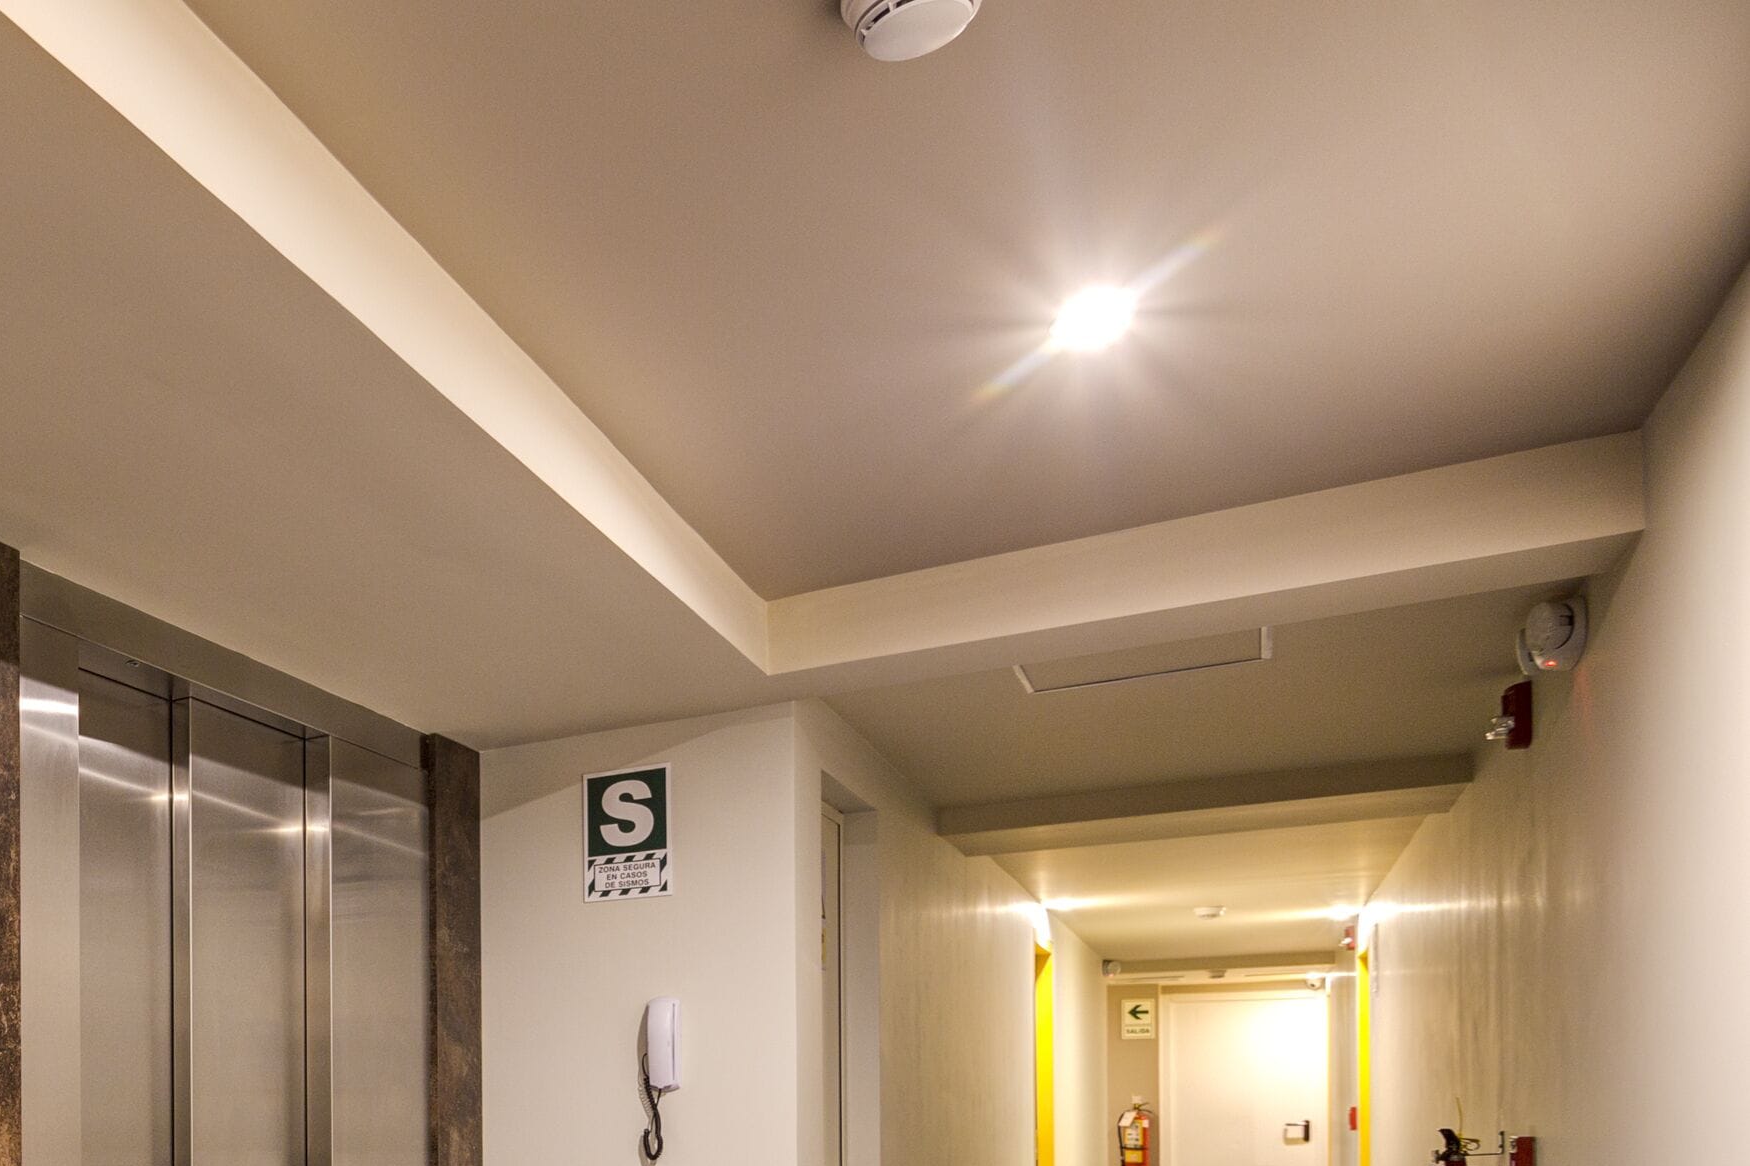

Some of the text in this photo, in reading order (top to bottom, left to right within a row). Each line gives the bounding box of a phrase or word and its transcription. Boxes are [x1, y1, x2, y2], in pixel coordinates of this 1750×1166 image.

[600, 779, 655, 847] S
[623, 862, 656, 871] SEGURA
[620, 871, 648, 879] CASOS
[618, 879, 650, 887] SISMOS
